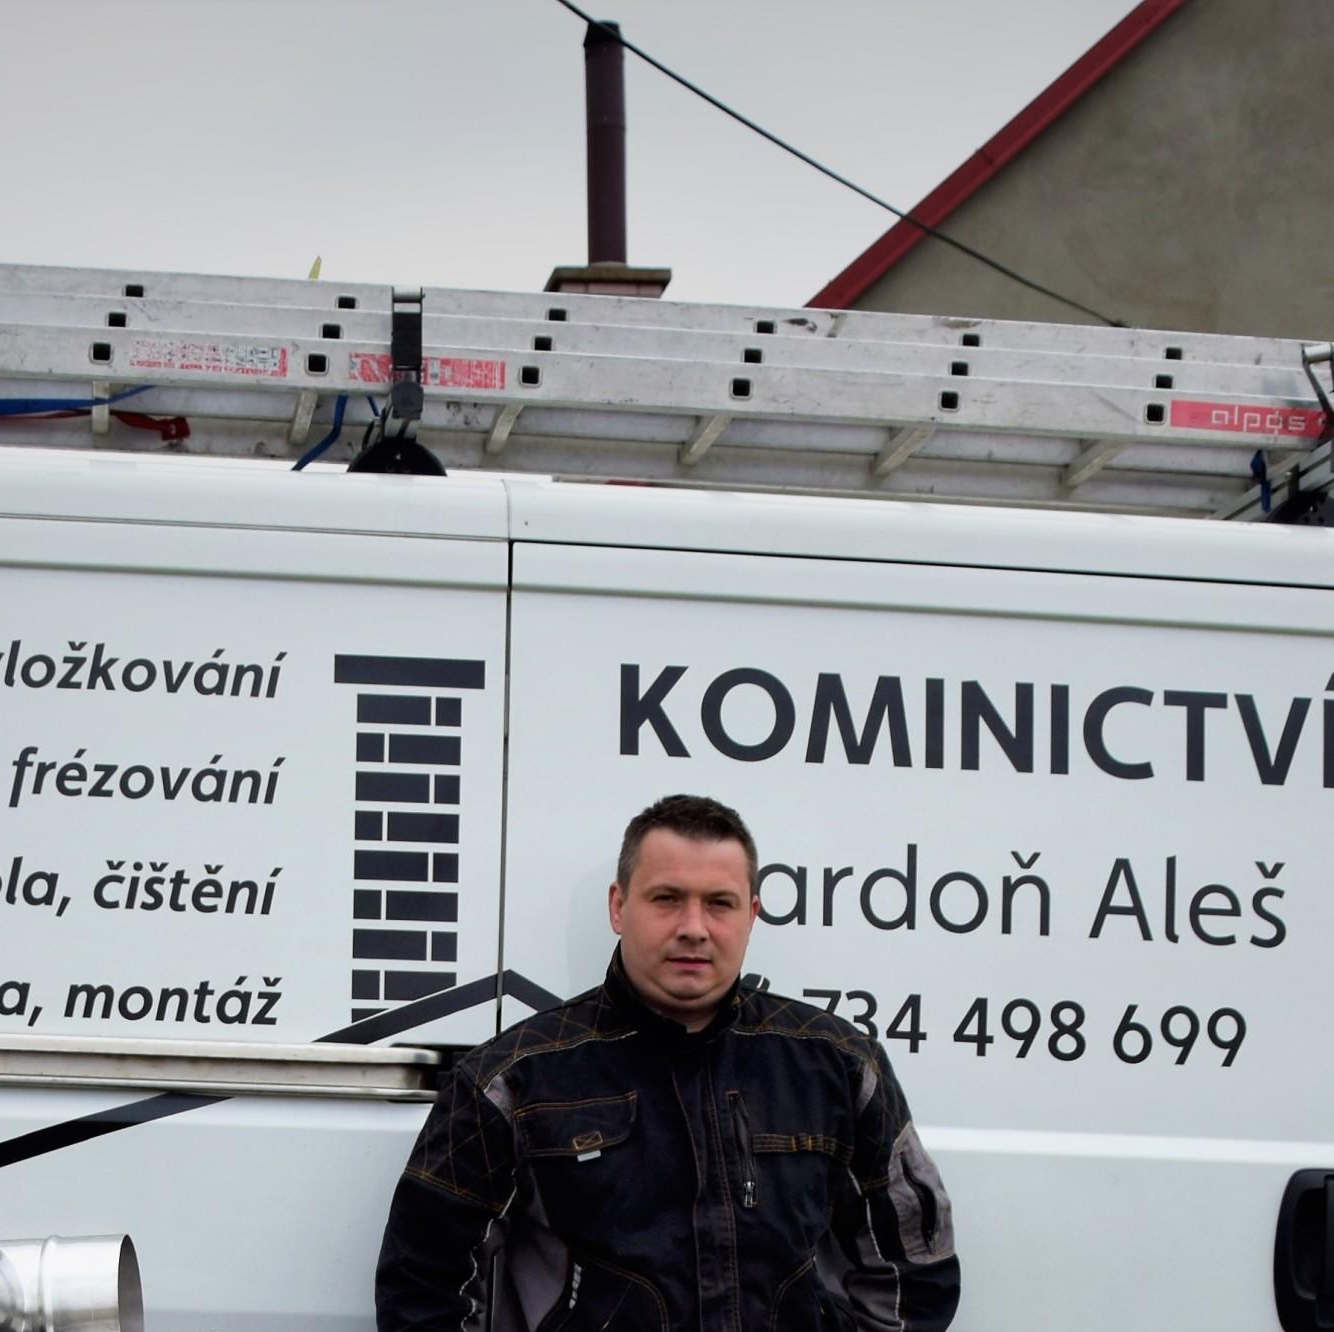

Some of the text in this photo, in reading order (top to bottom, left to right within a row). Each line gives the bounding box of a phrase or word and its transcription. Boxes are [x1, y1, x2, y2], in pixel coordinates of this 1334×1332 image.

[1211, 404, 1307, 433] alpos
[8, 746, 286, 808] frézování
[93, 859, 283, 916] čištění
[756, 843, 1287, 949] ardoň Aleš
[63, 975, 282, 1026] montáž
[803, 988, 1247, 1068] 734 498 699
